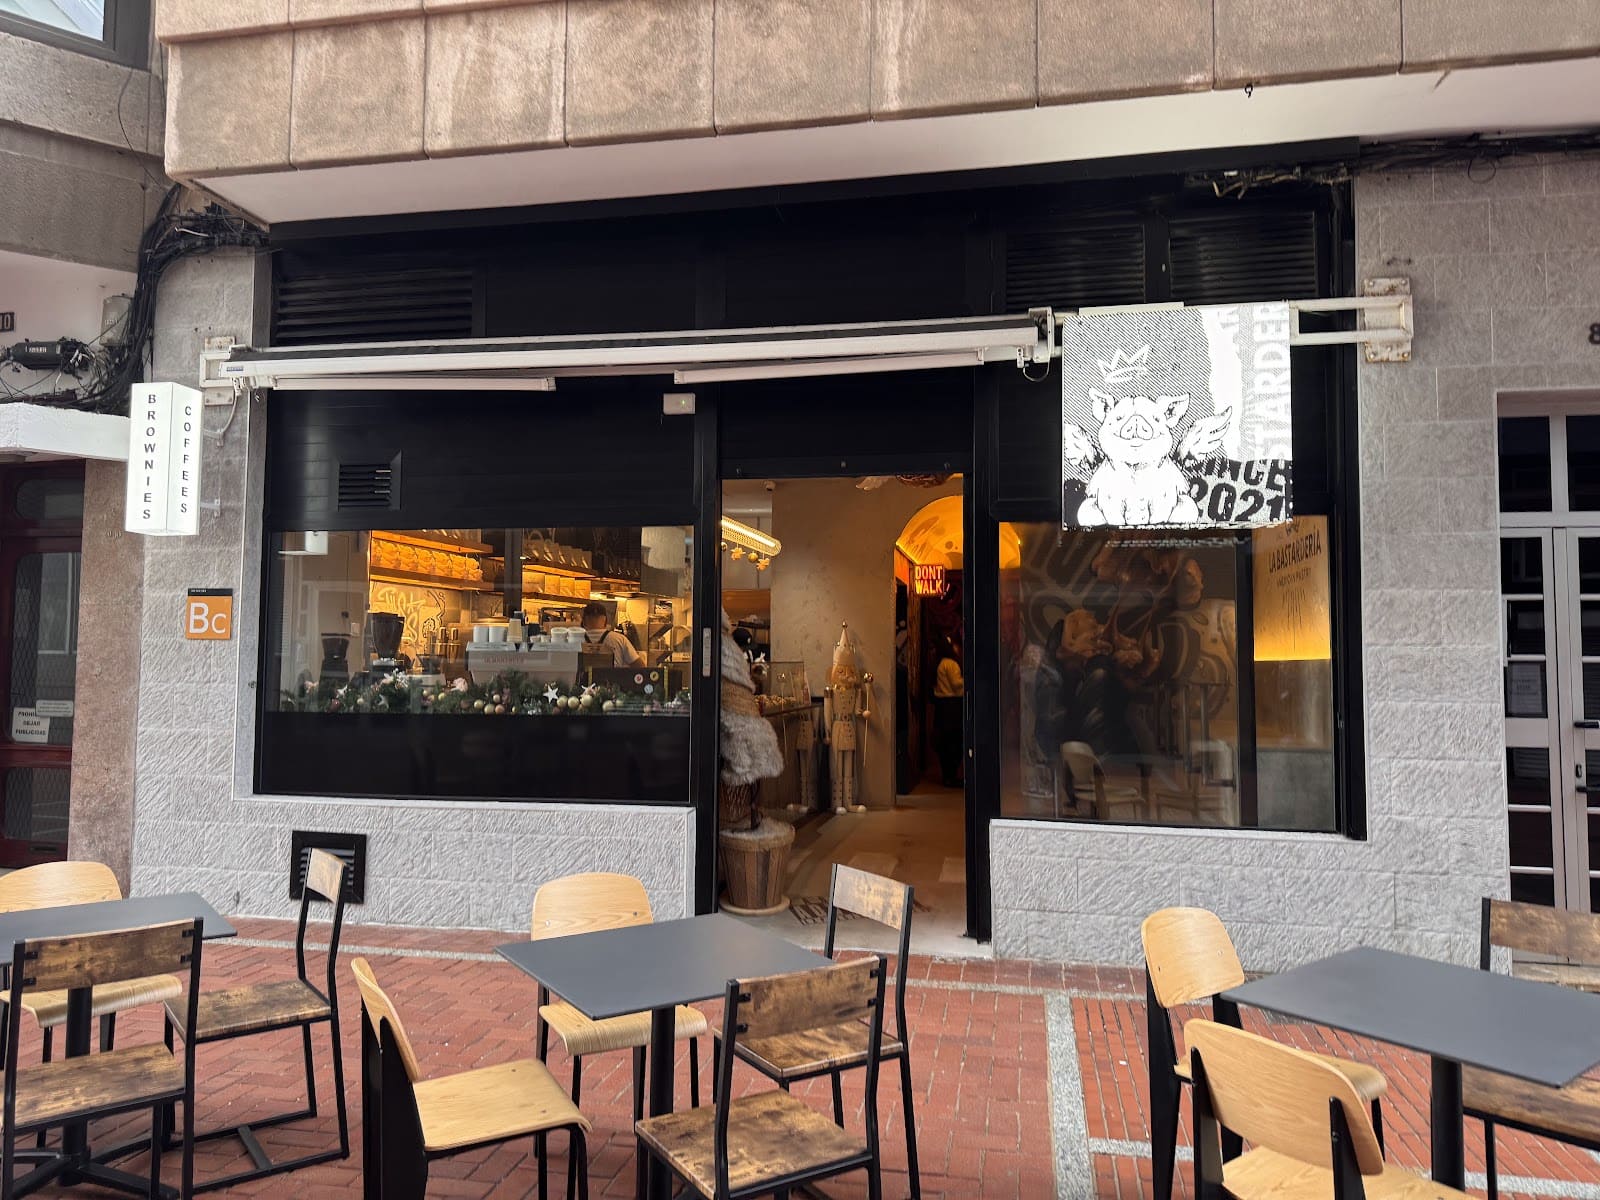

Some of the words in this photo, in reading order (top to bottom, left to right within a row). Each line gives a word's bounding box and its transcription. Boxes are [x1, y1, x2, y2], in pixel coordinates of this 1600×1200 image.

[142, 394, 157, 520] BROWNIES
[180, 405, 192, 513] COFFEES
[1189, 477, 1285, 522] 2021
[915, 565, 943, 580] DONT
[915, 579, 943, 594] WALK
